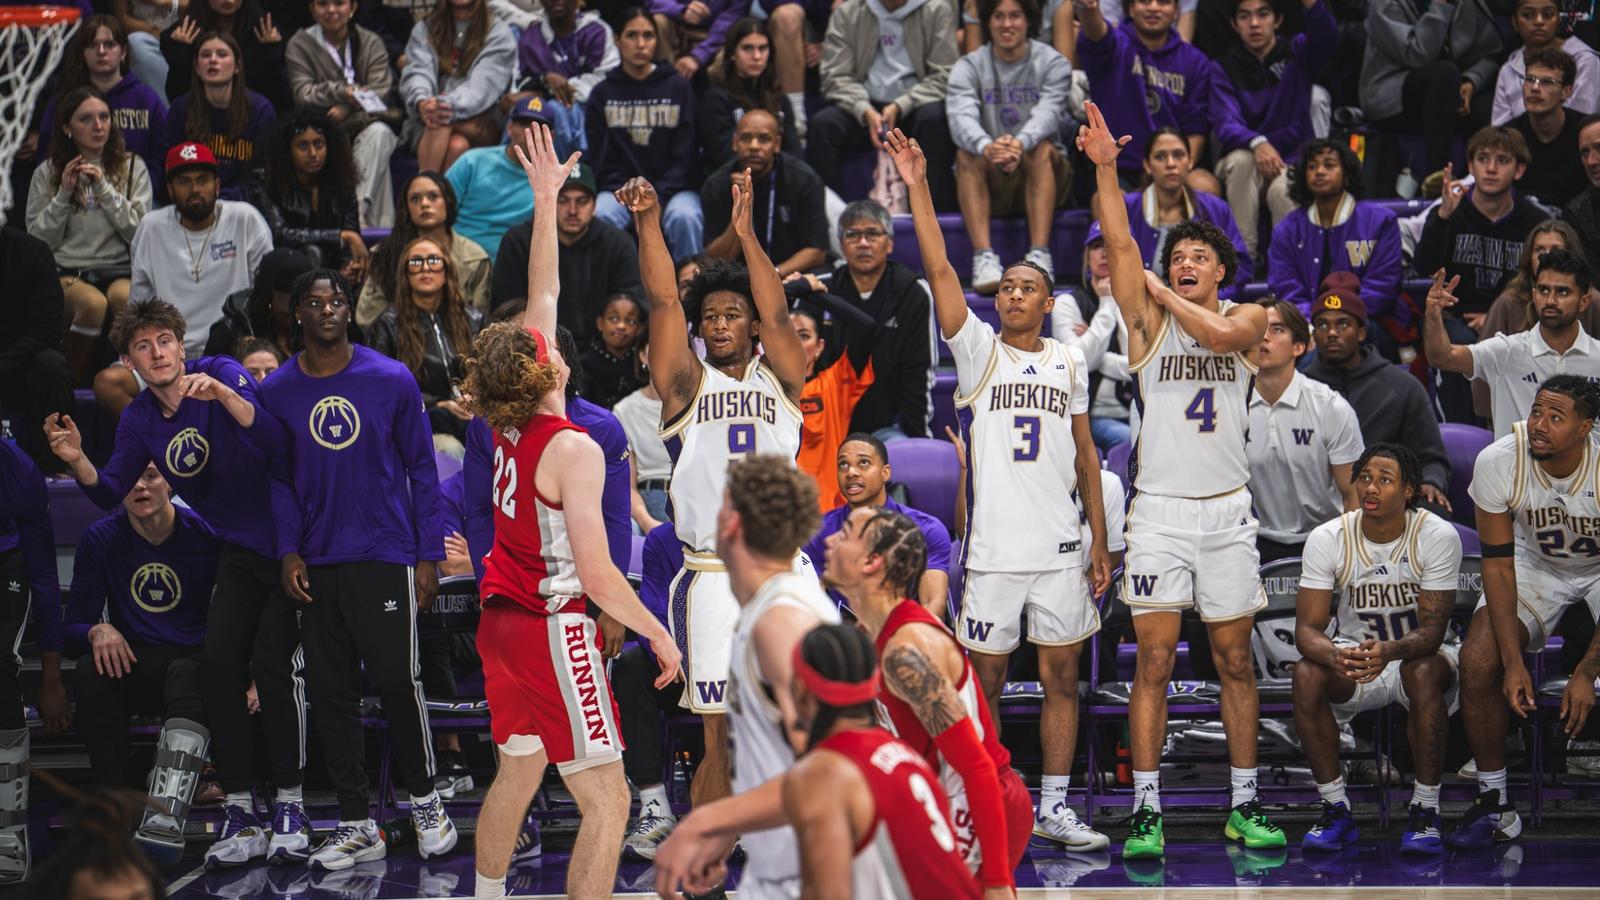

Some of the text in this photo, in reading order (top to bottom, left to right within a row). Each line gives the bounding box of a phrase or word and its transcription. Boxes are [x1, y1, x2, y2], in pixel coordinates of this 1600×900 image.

[1345, 240, 1377, 267] W
[1158, 354, 1236, 383] HUSKIES
[988, 383, 1068, 419] HUSKIES
[1184, 386, 1217, 433] 4
[1013, 415, 1041, 462] 3
[1291, 428, 1314, 445] W
[493, 445, 517, 520] 22
[1131, 575, 1158, 596] W
[967, 616, 994, 642] W
[565, 623, 610, 746] RUNNIN'
[696, 680, 727, 704] W
[908, 772, 955, 852] 3
